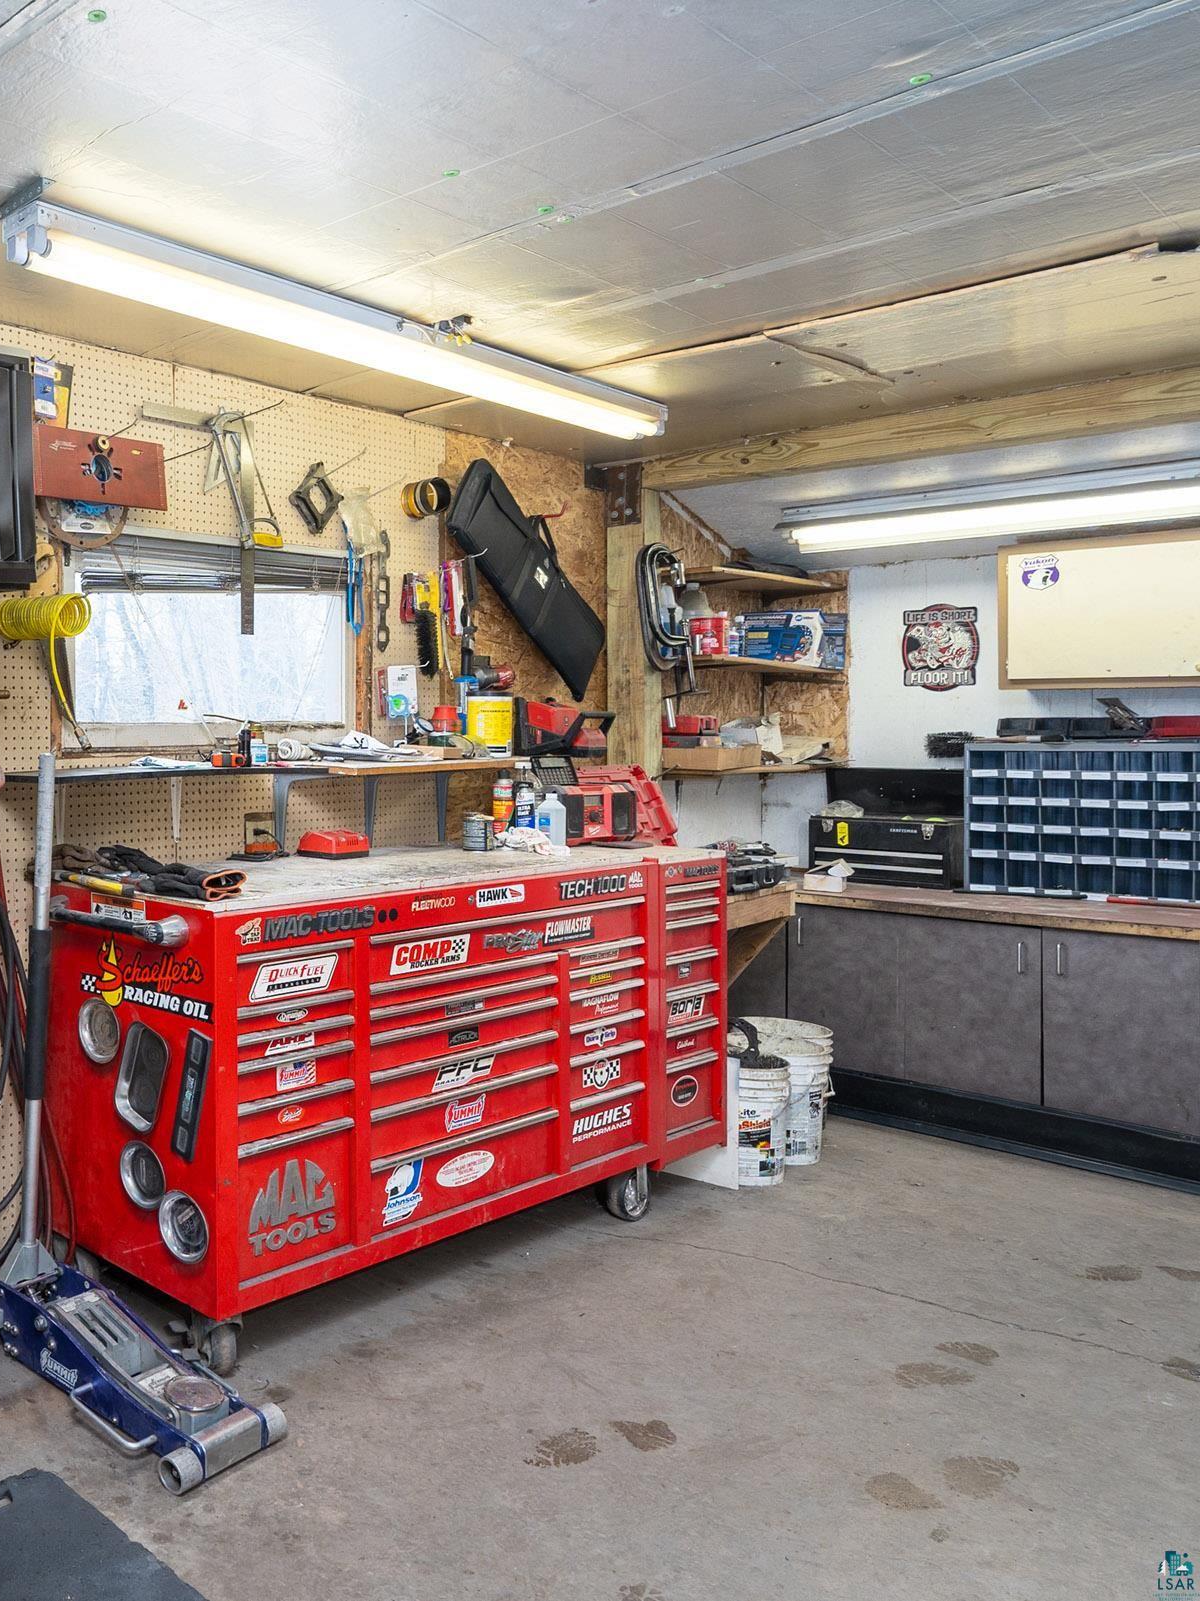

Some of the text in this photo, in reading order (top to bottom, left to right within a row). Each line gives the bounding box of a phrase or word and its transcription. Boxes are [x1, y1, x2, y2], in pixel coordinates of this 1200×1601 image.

[906, 612, 927, 622] LIFE
[928, 612, 939, 621] IS
[910, 671, 969, 684] FLOOR IT!
[478, 888, 508, 903] HAWK
[560, 874, 627, 900] TECH 1000
[411, 896, 456, 912] FLEETWOOD
[263, 906, 376, 942] MAC TOOLS
[544, 916, 592, 944] FLOWMASTER
[395, 938, 453, 966] COMP
[409, 952, 461, 969] ROCKER ARMS
[96, 945, 204, 993] Schaeffer's
[268, 964, 325, 983] QUICK FUEL
[124, 985, 210, 1020] RACING OIL
[582, 992, 620, 1008] MAGNAFLOW
[279, 1066, 308, 1086] SUMMIT
[437, 1053, 495, 1081] PFC
[435, 1077, 466, 1086] BRAKES
[446, 1099, 485, 1128] SUMMIT
[572, 1103, 633, 1136] HUGHES
[572, 1118, 633, 1144] PERFORMANCE
[250, 1159, 336, 1233] MAC
[386, 1194, 421, 1210] Johnson
[248, 1211, 337, 1256] TOOLS
[40, 1348, 78, 1387] SUMMIT
